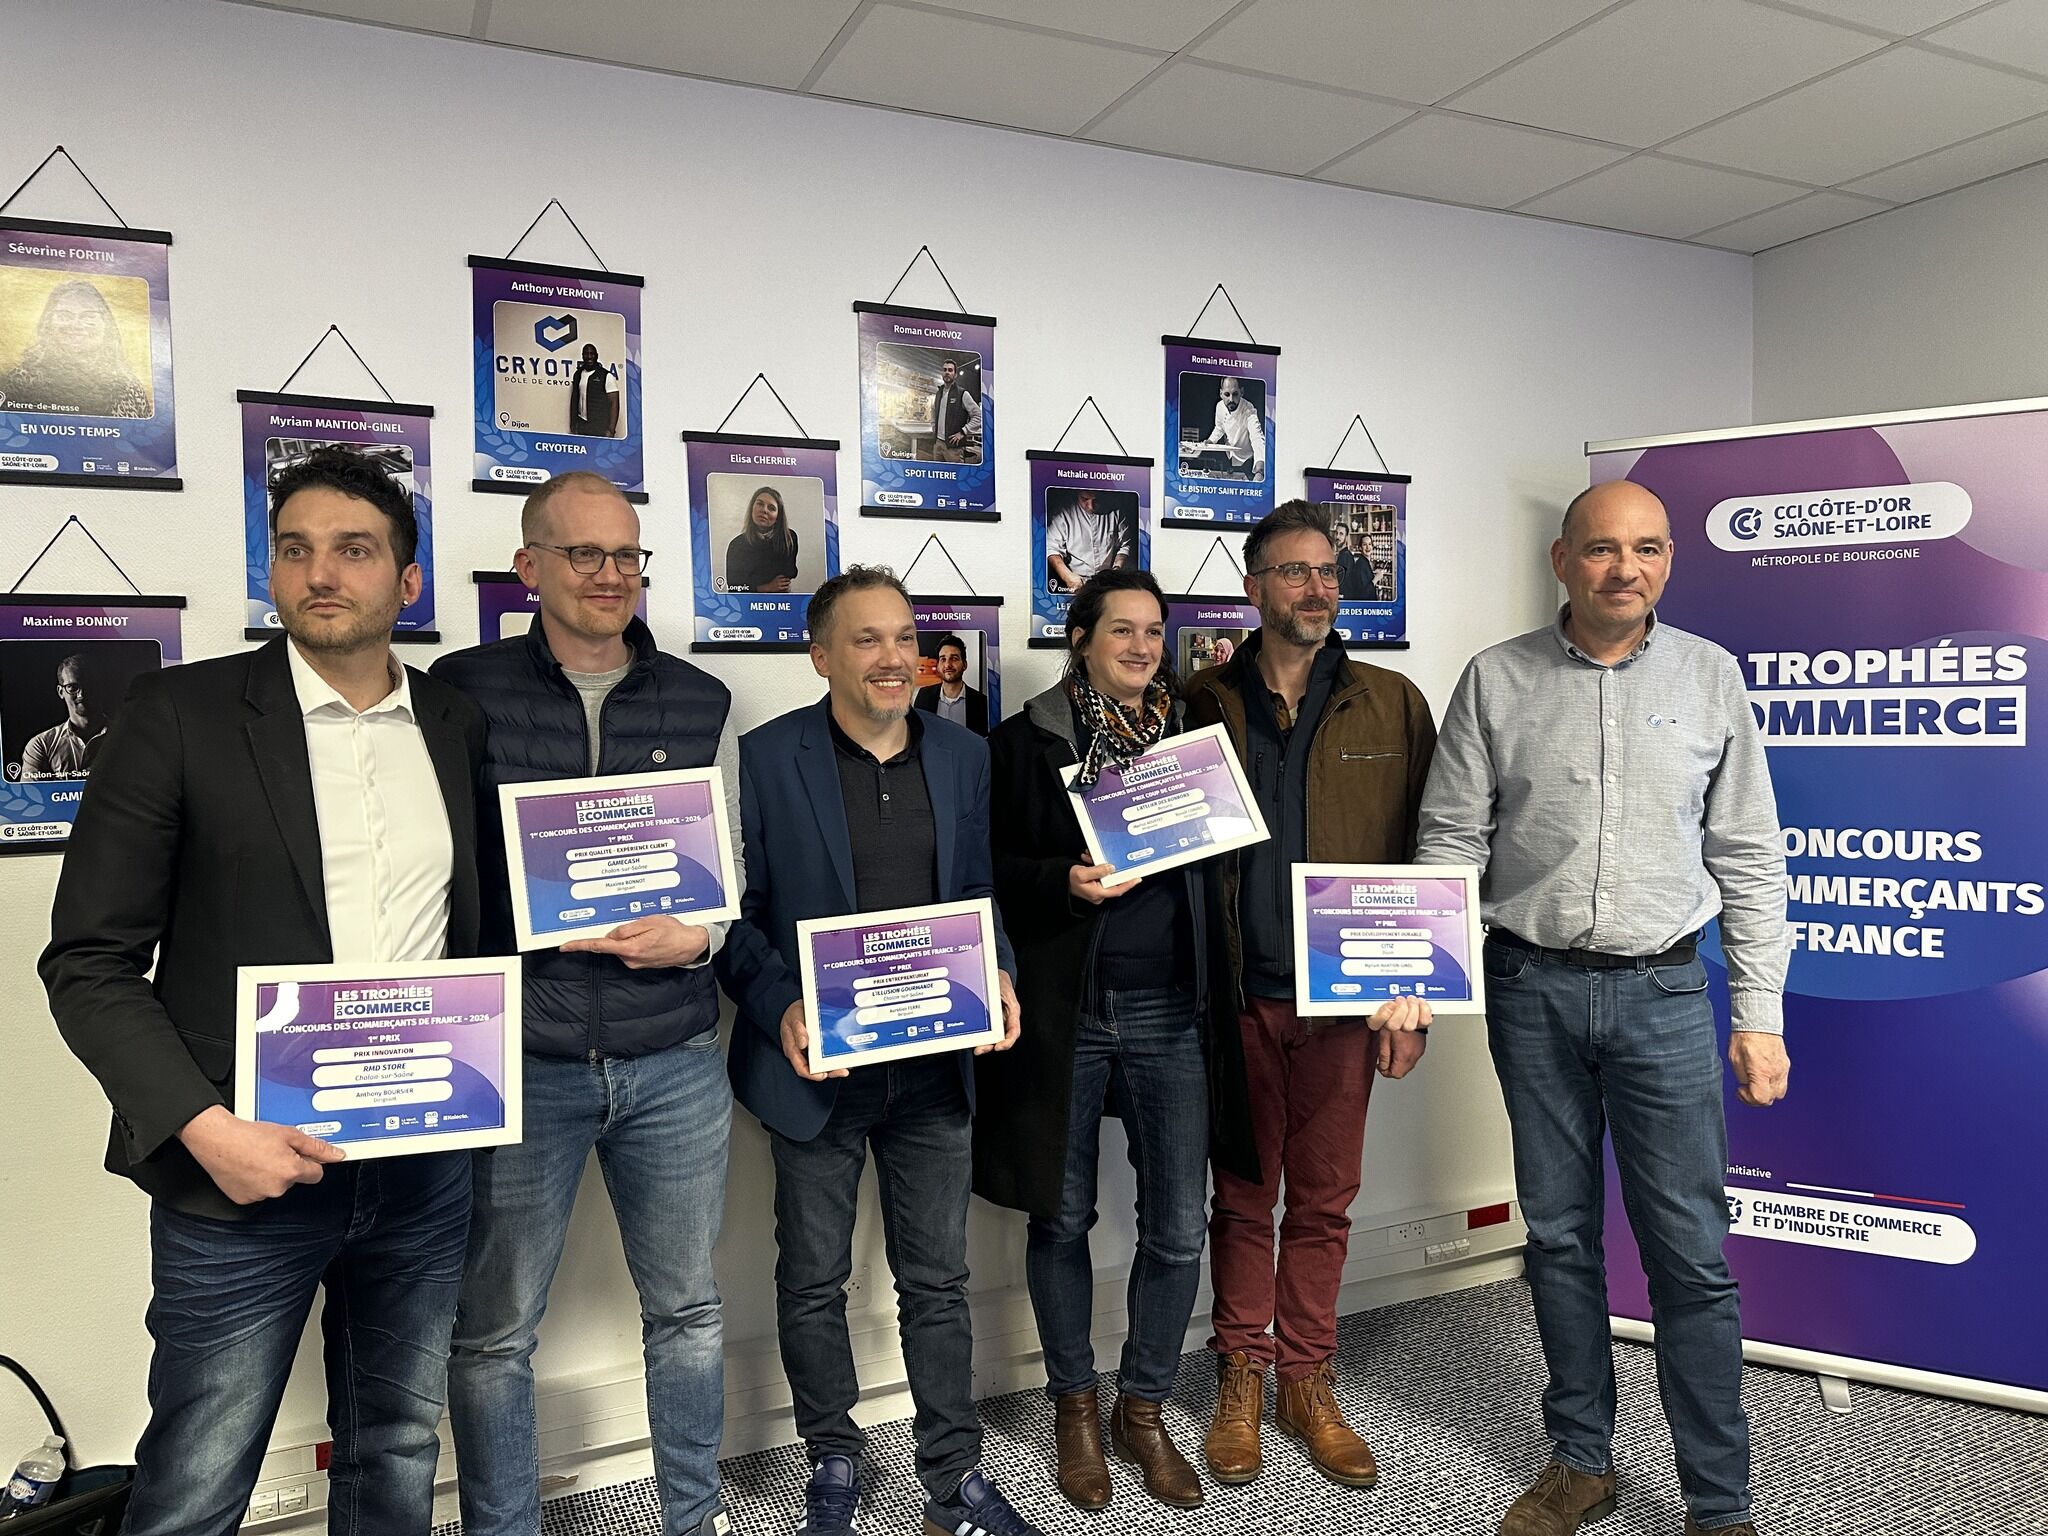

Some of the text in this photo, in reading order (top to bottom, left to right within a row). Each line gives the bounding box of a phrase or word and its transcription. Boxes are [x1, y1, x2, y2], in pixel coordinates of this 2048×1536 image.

[8, 242, 115, 262] Séverine FORTIN
[512, 282, 604, 300] Anthony VERMONT
[894, 325, 962, 340] Roman CHORVOZ
[496, 356, 619, 380] CRYOTA
[1192, 356, 1253, 368] Romain PELLETIER
[505, 376, 527, 384] PÔLE
[7, 400, 80, 412] Pierre-de-Bresse
[20, 424, 120, 438] EN VOUS TEMPS
[270, 416, 404, 433] Myriam MANTION-GINEL
[536, 442, 587, 454] CRYOTERA
[730, 454, 797, 466] Elisa CHERRIER
[905, 469, 957, 480] SPOT LITERIE
[1058, 470, 1125, 481] Nathalie LIODENOT
[1189, 486, 1218, 494] BISTROT
[1218, 487, 1238, 495] SAINT
[1334, 482, 1382, 492] Marion AOUSTET
[1774, 505, 1802, 521] CCI
[1774, 514, 1932, 538] SAÔNE-ET-LOIRE
[1751, 548, 1920, 567] MÉTROPOLE DE BOURGOGNE
[750, 603, 776, 611] MEND
[23, 616, 128, 626] Maxime BONNOT
[1198, 611, 1221, 619] Justine
[1748, 638, 2028, 686] TROPHÉES
[1135, 755, 1178, 772] TROPHÉES
[22, 769, 90, 779] Chalon-sur-Saô
[1129, 764, 1180, 784] COMMERCE
[1098, 790, 1126, 802] CONCOURS
[1137, 776, 1175, 790] COMMERÇANTS
[1183, 768, 1202, 777] FRANCE
[576, 794, 654, 810] LES TROPHÉES
[1132, 794, 1144, 802] PRIX
[1145, 790, 1160, 799] COUP
[585, 806, 653, 820] COMMERCE
[539, 828, 577, 838] CONCOURS
[594, 821, 644, 832] COMMERÇANTS
[617, 834, 634, 842] PRIX
[1780, 827, 1983, 863] ONCOURS
[608, 858, 640, 866] GAMECASH
[1351, 883, 1417, 893] LES TROPHÉES
[1359, 896, 1415, 904] COMMERCE
[1786, 874, 2045, 920] MMERÇANTS
[863, 925, 931, 942] LES TROPHÉES
[1787, 921, 1944, 958] FRANCE
[871, 936, 930, 952] COMMERCE
[831, 959, 864, 969] CONCOURS
[878, 951, 922, 963] COMMERÇANTS
[932, 946, 953, 956] FRANCE
[958, 944, 972, 952] 2026
[334, 985, 432, 1001] LES TROPHÉES
[901, 983, 933, 992] GOURMANDE
[344, 1001, 430, 1016] COMMERCE
[283, 1024, 332, 1033] CONCOURS
[334, 1022, 351, 1030] DES
[353, 1018, 416, 1029] COMMERÇANTS
[431, 1016, 462, 1024] FRANCE
[469, 1014, 489, 1022] 2026
[380, 1034, 400, 1042] PRIX
[372, 1048, 414, 1056] INNOVATION
[1726, 1164, 1771, 1179] initiative
[1753, 1200, 1942, 1236] CHAMBRE DE COMMERCE
[1753, 1216, 1869, 1242] ET D'INDUSTRIE
